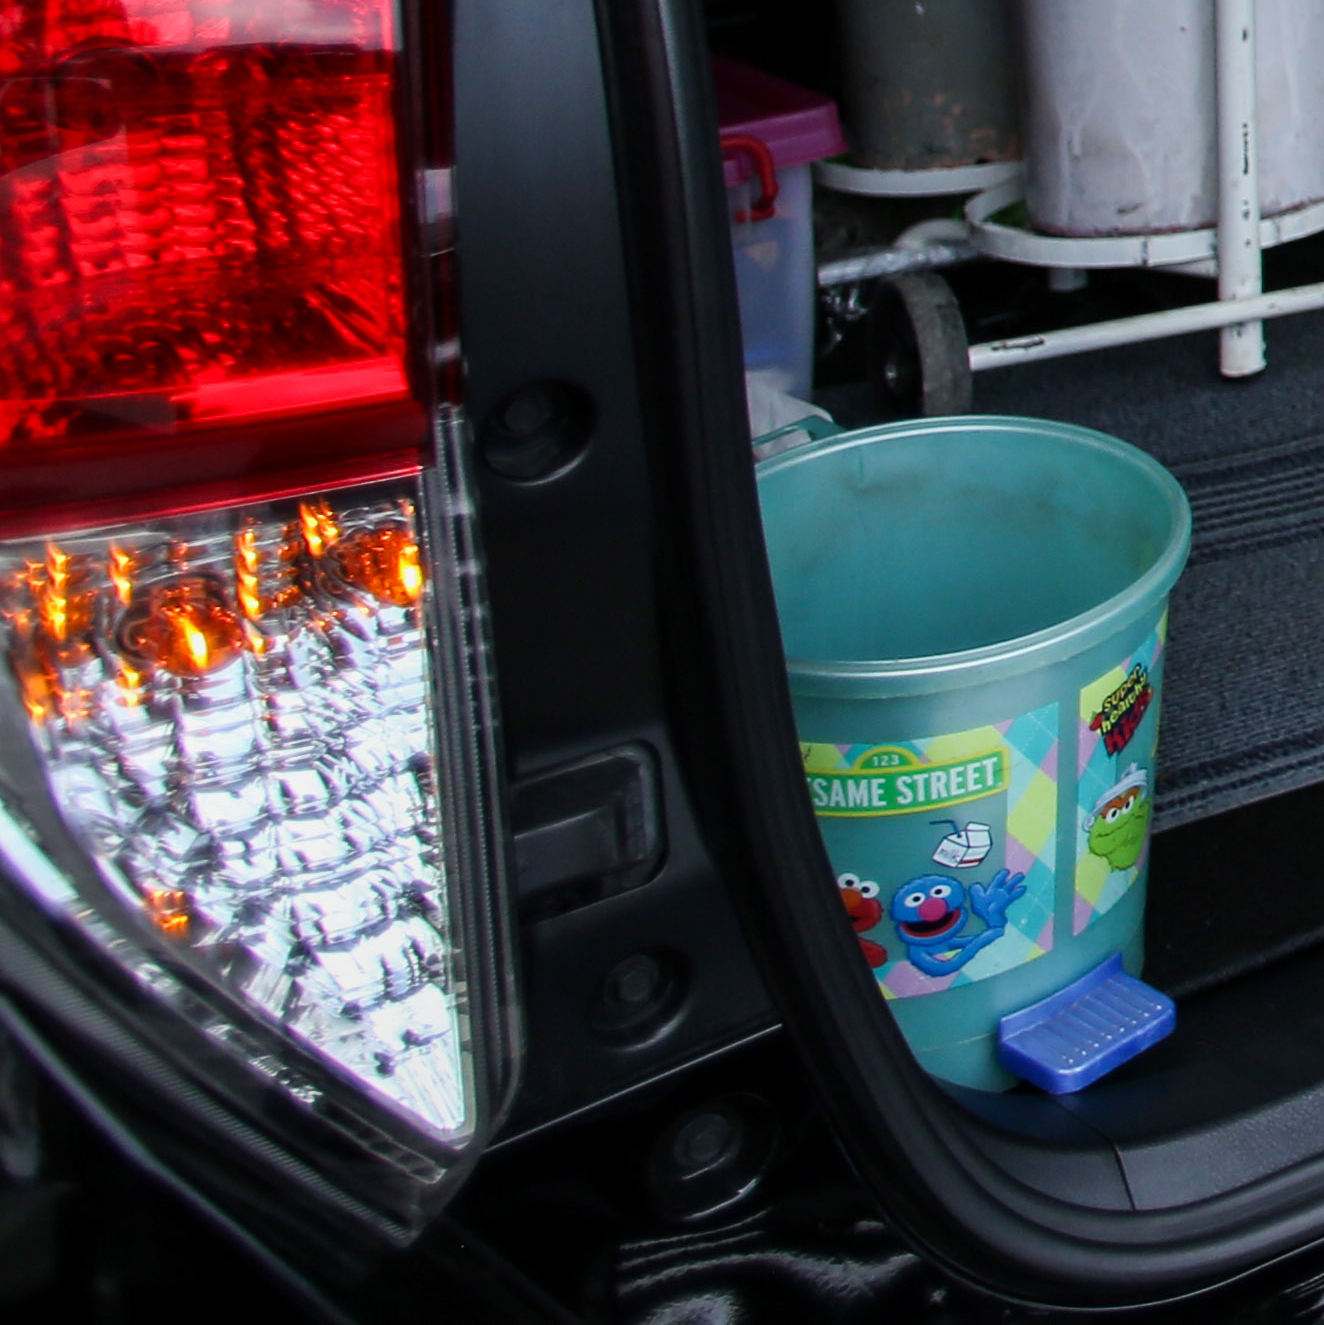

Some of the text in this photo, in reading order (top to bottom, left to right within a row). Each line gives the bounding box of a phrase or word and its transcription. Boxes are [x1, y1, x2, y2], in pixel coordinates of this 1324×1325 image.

[872, 754, 900, 768] 123
[806, 756, 999, 809] SAME STREET
